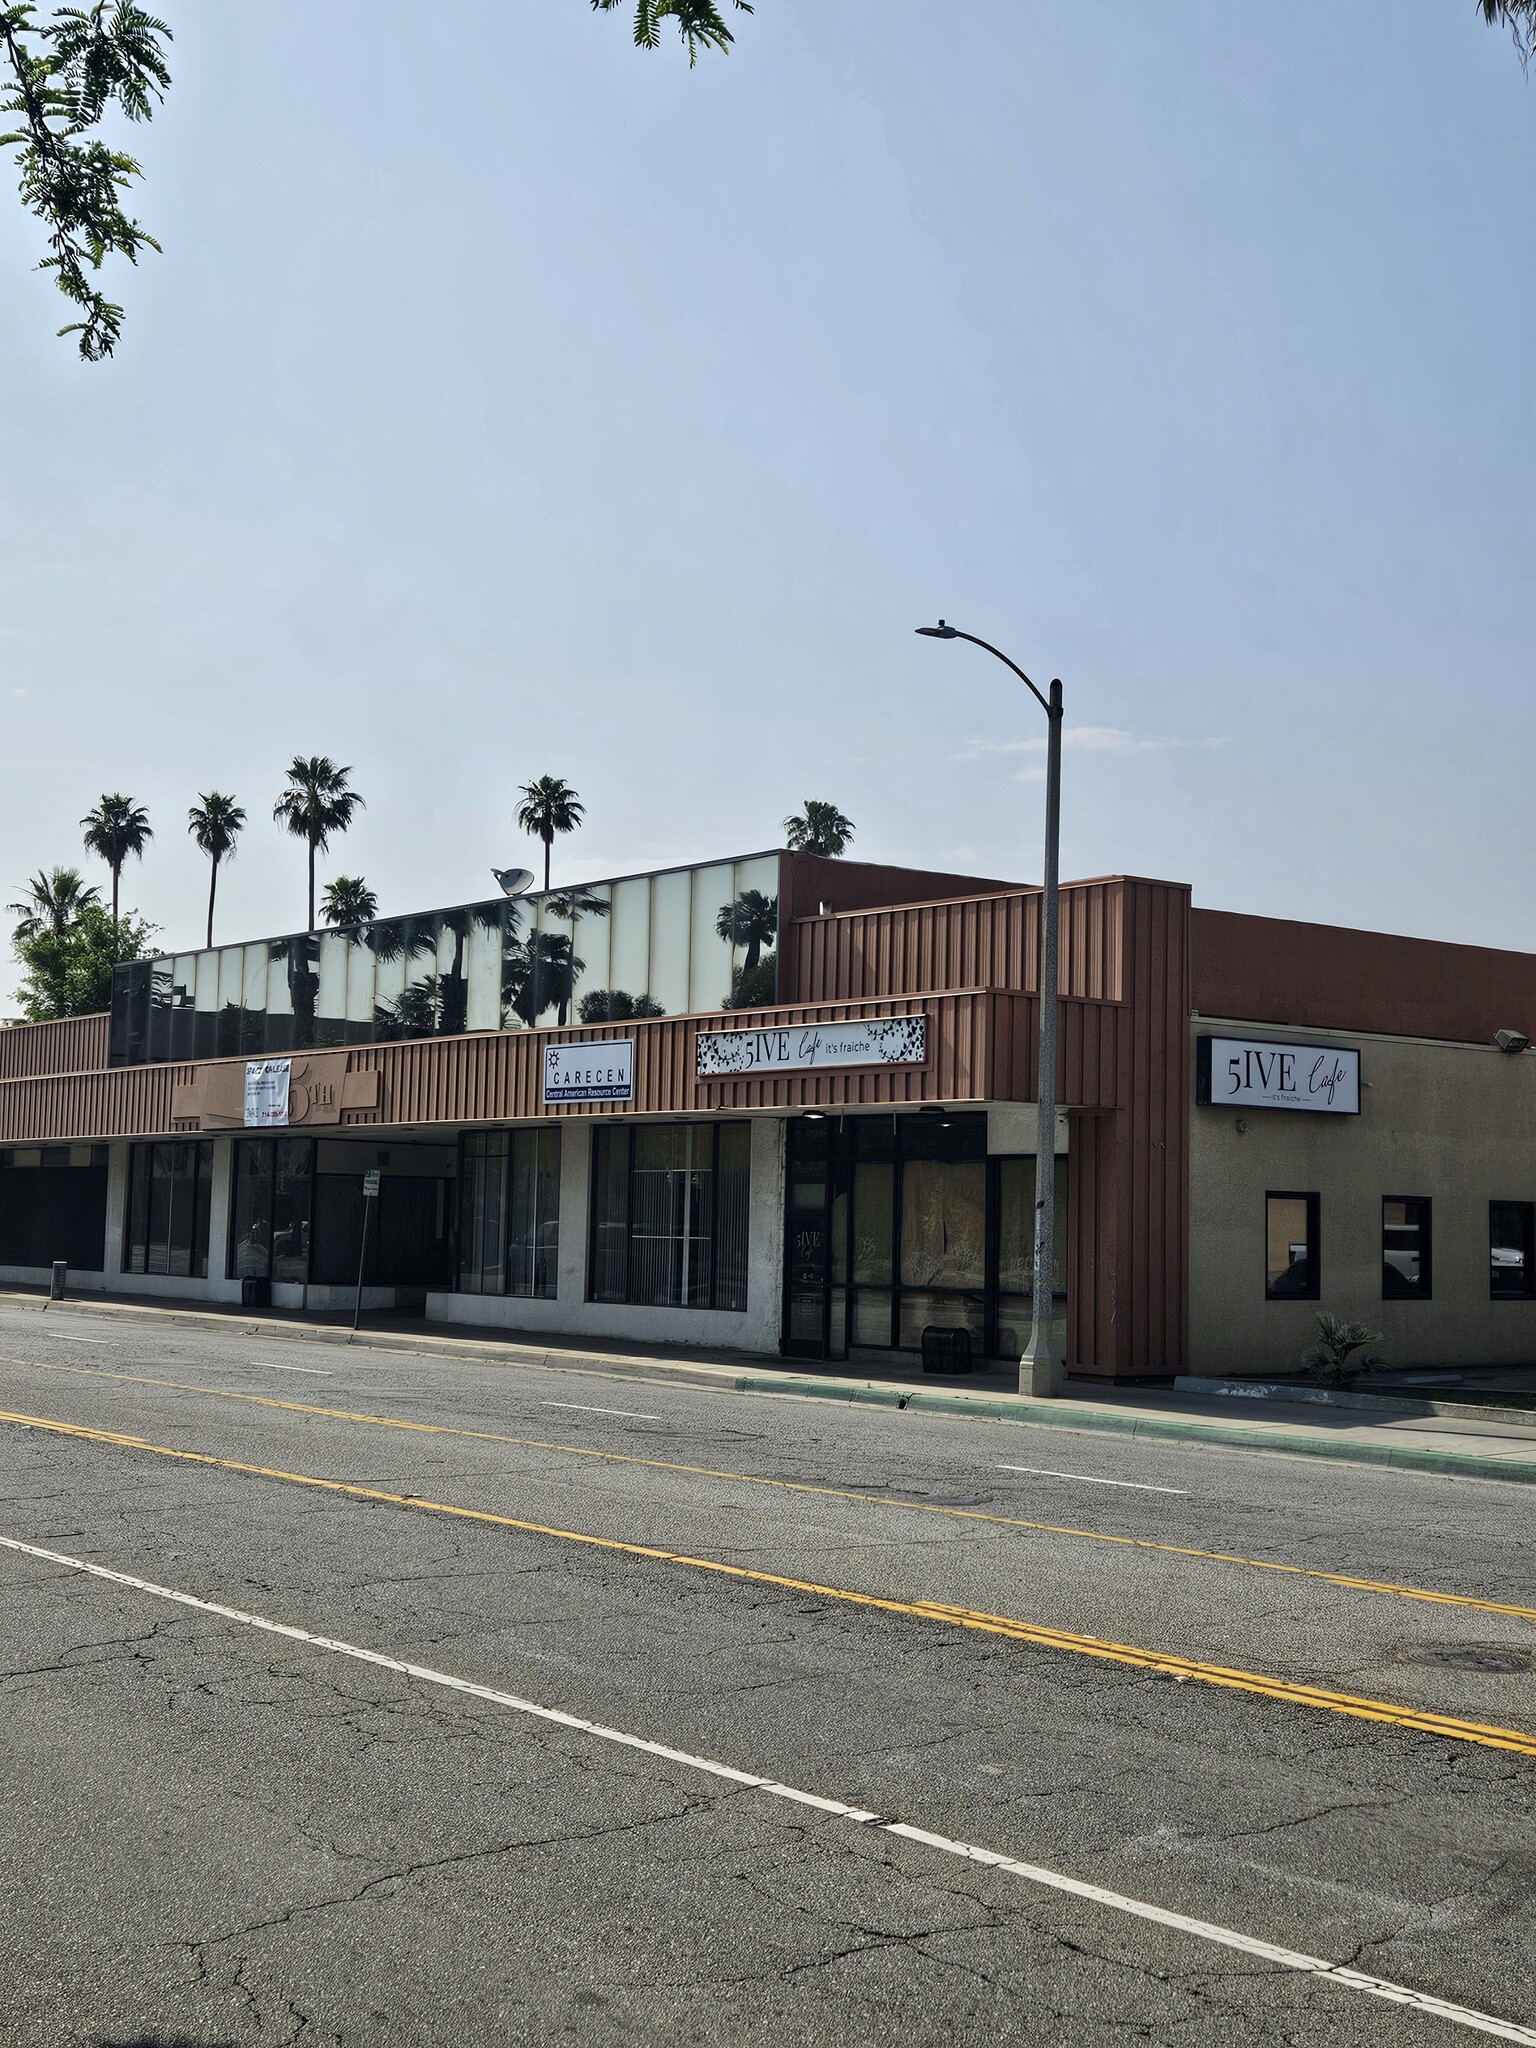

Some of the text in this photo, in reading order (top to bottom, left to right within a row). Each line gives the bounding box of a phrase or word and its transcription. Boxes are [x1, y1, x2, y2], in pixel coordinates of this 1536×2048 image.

[745, 1031, 790, 1069] 5IVE
[825, 1043, 838, 1054] it's
[839, 1041, 870, 1053] fraiche
[554, 1068, 625, 1085] CARECEN
[1228, 1050, 1348, 1105] 5IVE Cafe
[546, 1086, 630, 1098] Central American Resource Center
